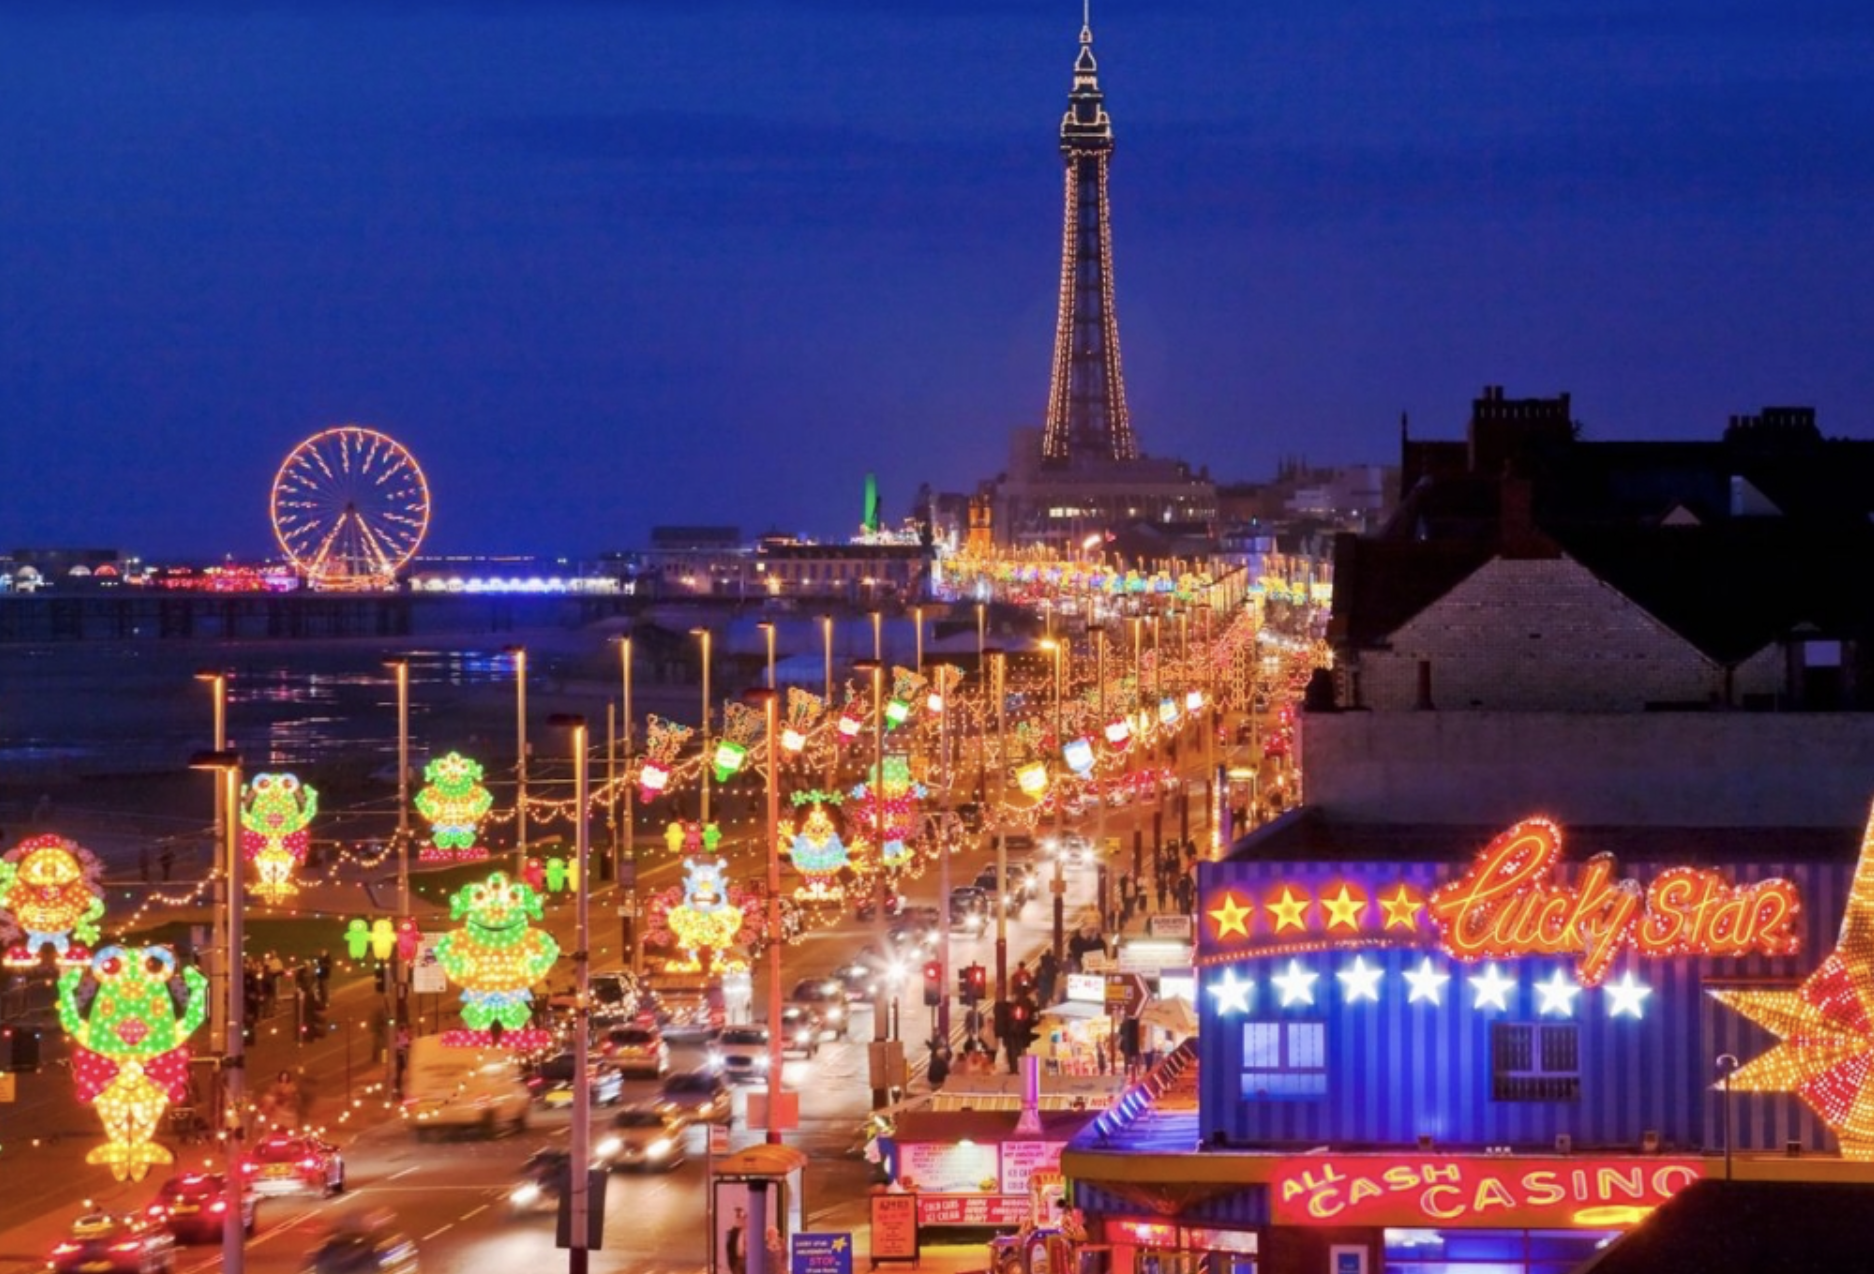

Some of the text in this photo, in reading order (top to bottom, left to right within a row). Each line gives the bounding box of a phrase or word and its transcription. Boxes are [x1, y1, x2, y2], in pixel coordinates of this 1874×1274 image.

[1431, 822, 1641, 981] Lucky
[1282, 1164, 1699, 1218] ALL CASH CASINO
